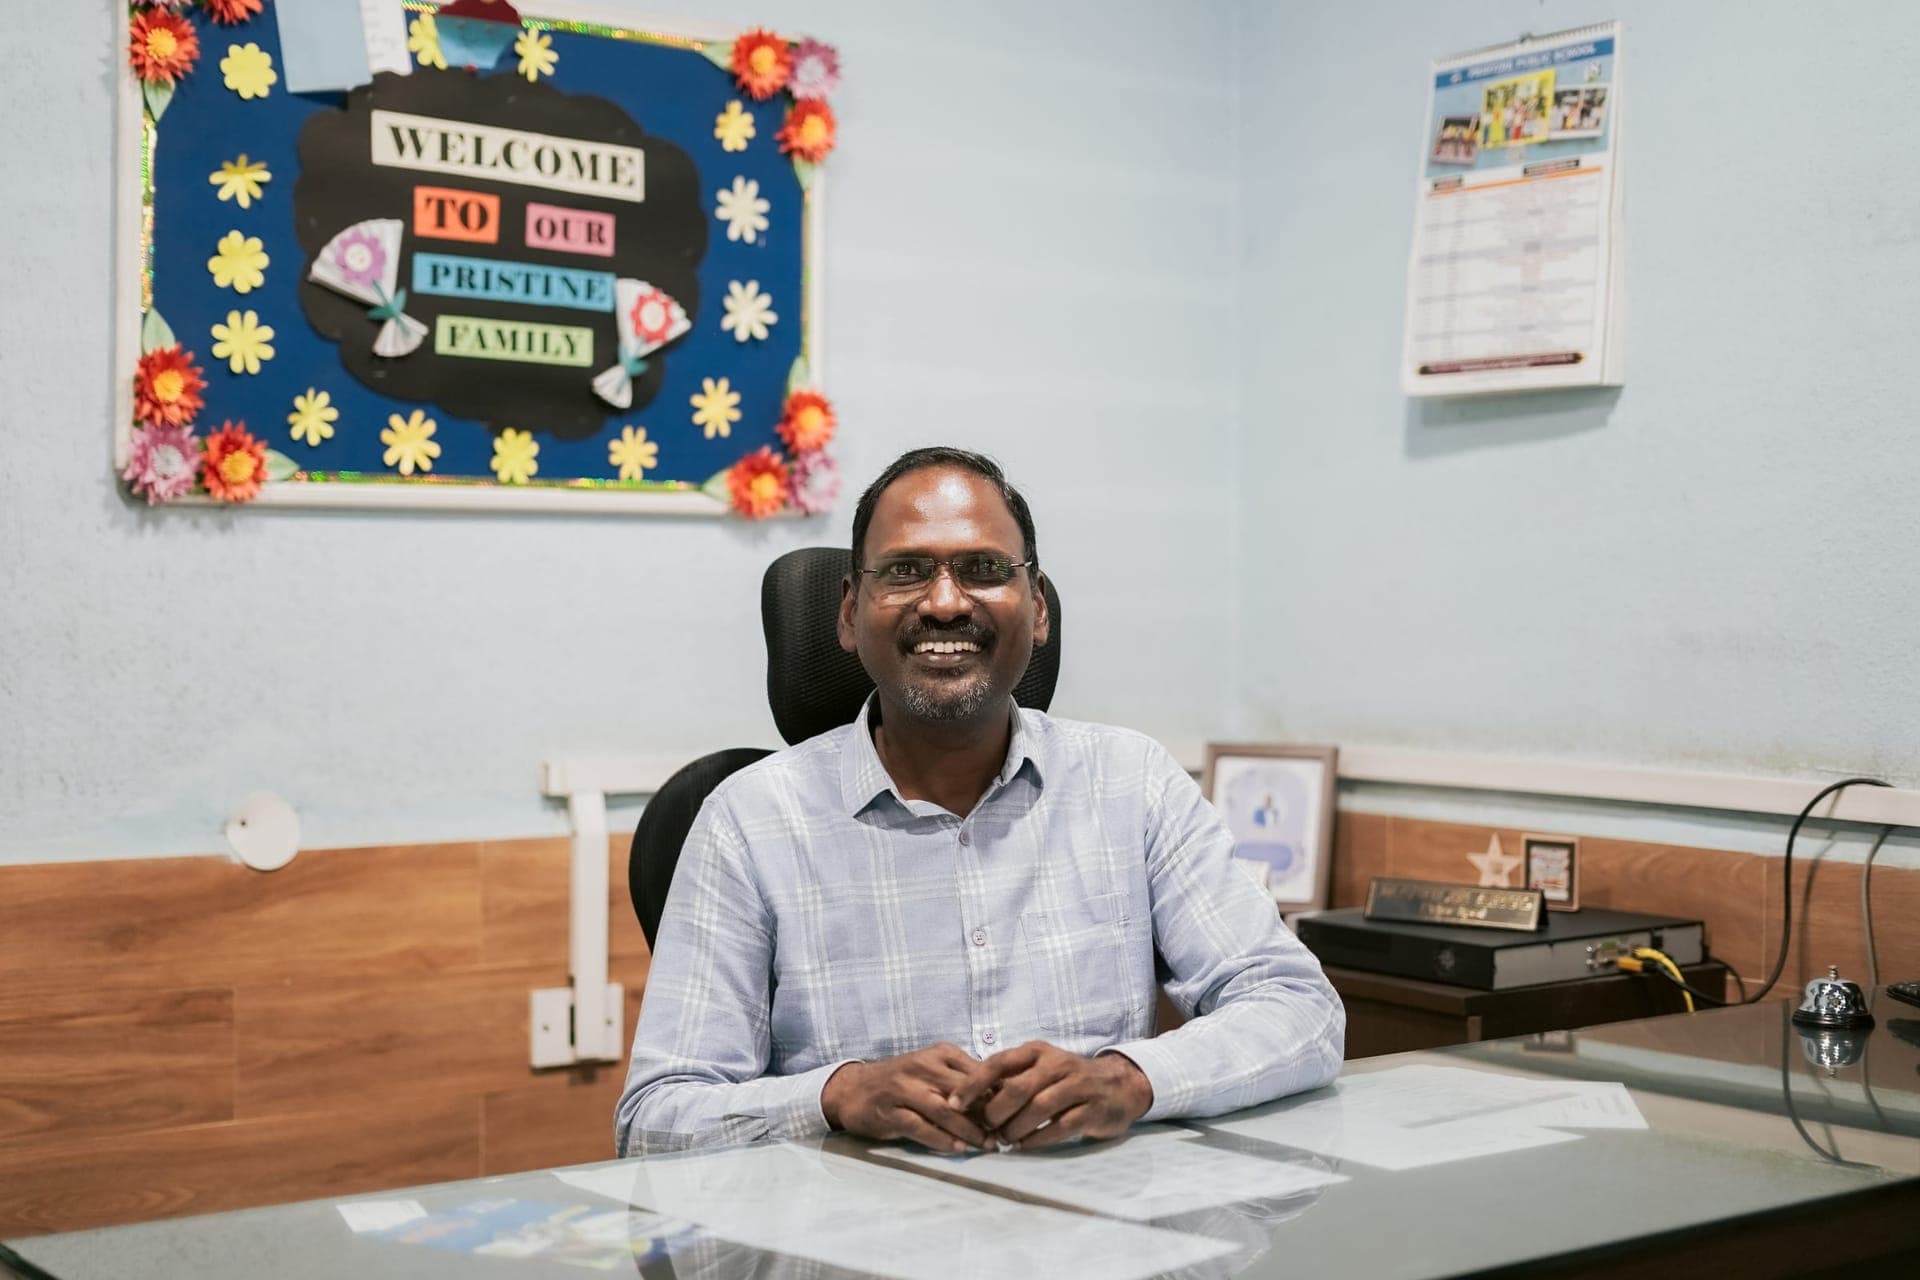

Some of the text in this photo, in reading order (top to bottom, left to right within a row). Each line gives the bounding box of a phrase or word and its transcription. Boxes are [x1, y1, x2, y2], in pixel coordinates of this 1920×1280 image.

[1553, 44, 1596, 62] SCHOOL
[389, 125, 635, 187] WELCOME
[425, 196, 606, 245] TO OUR
[429, 263, 606, 301] PRISTINE
[449, 325, 582, 357] FAMILY
